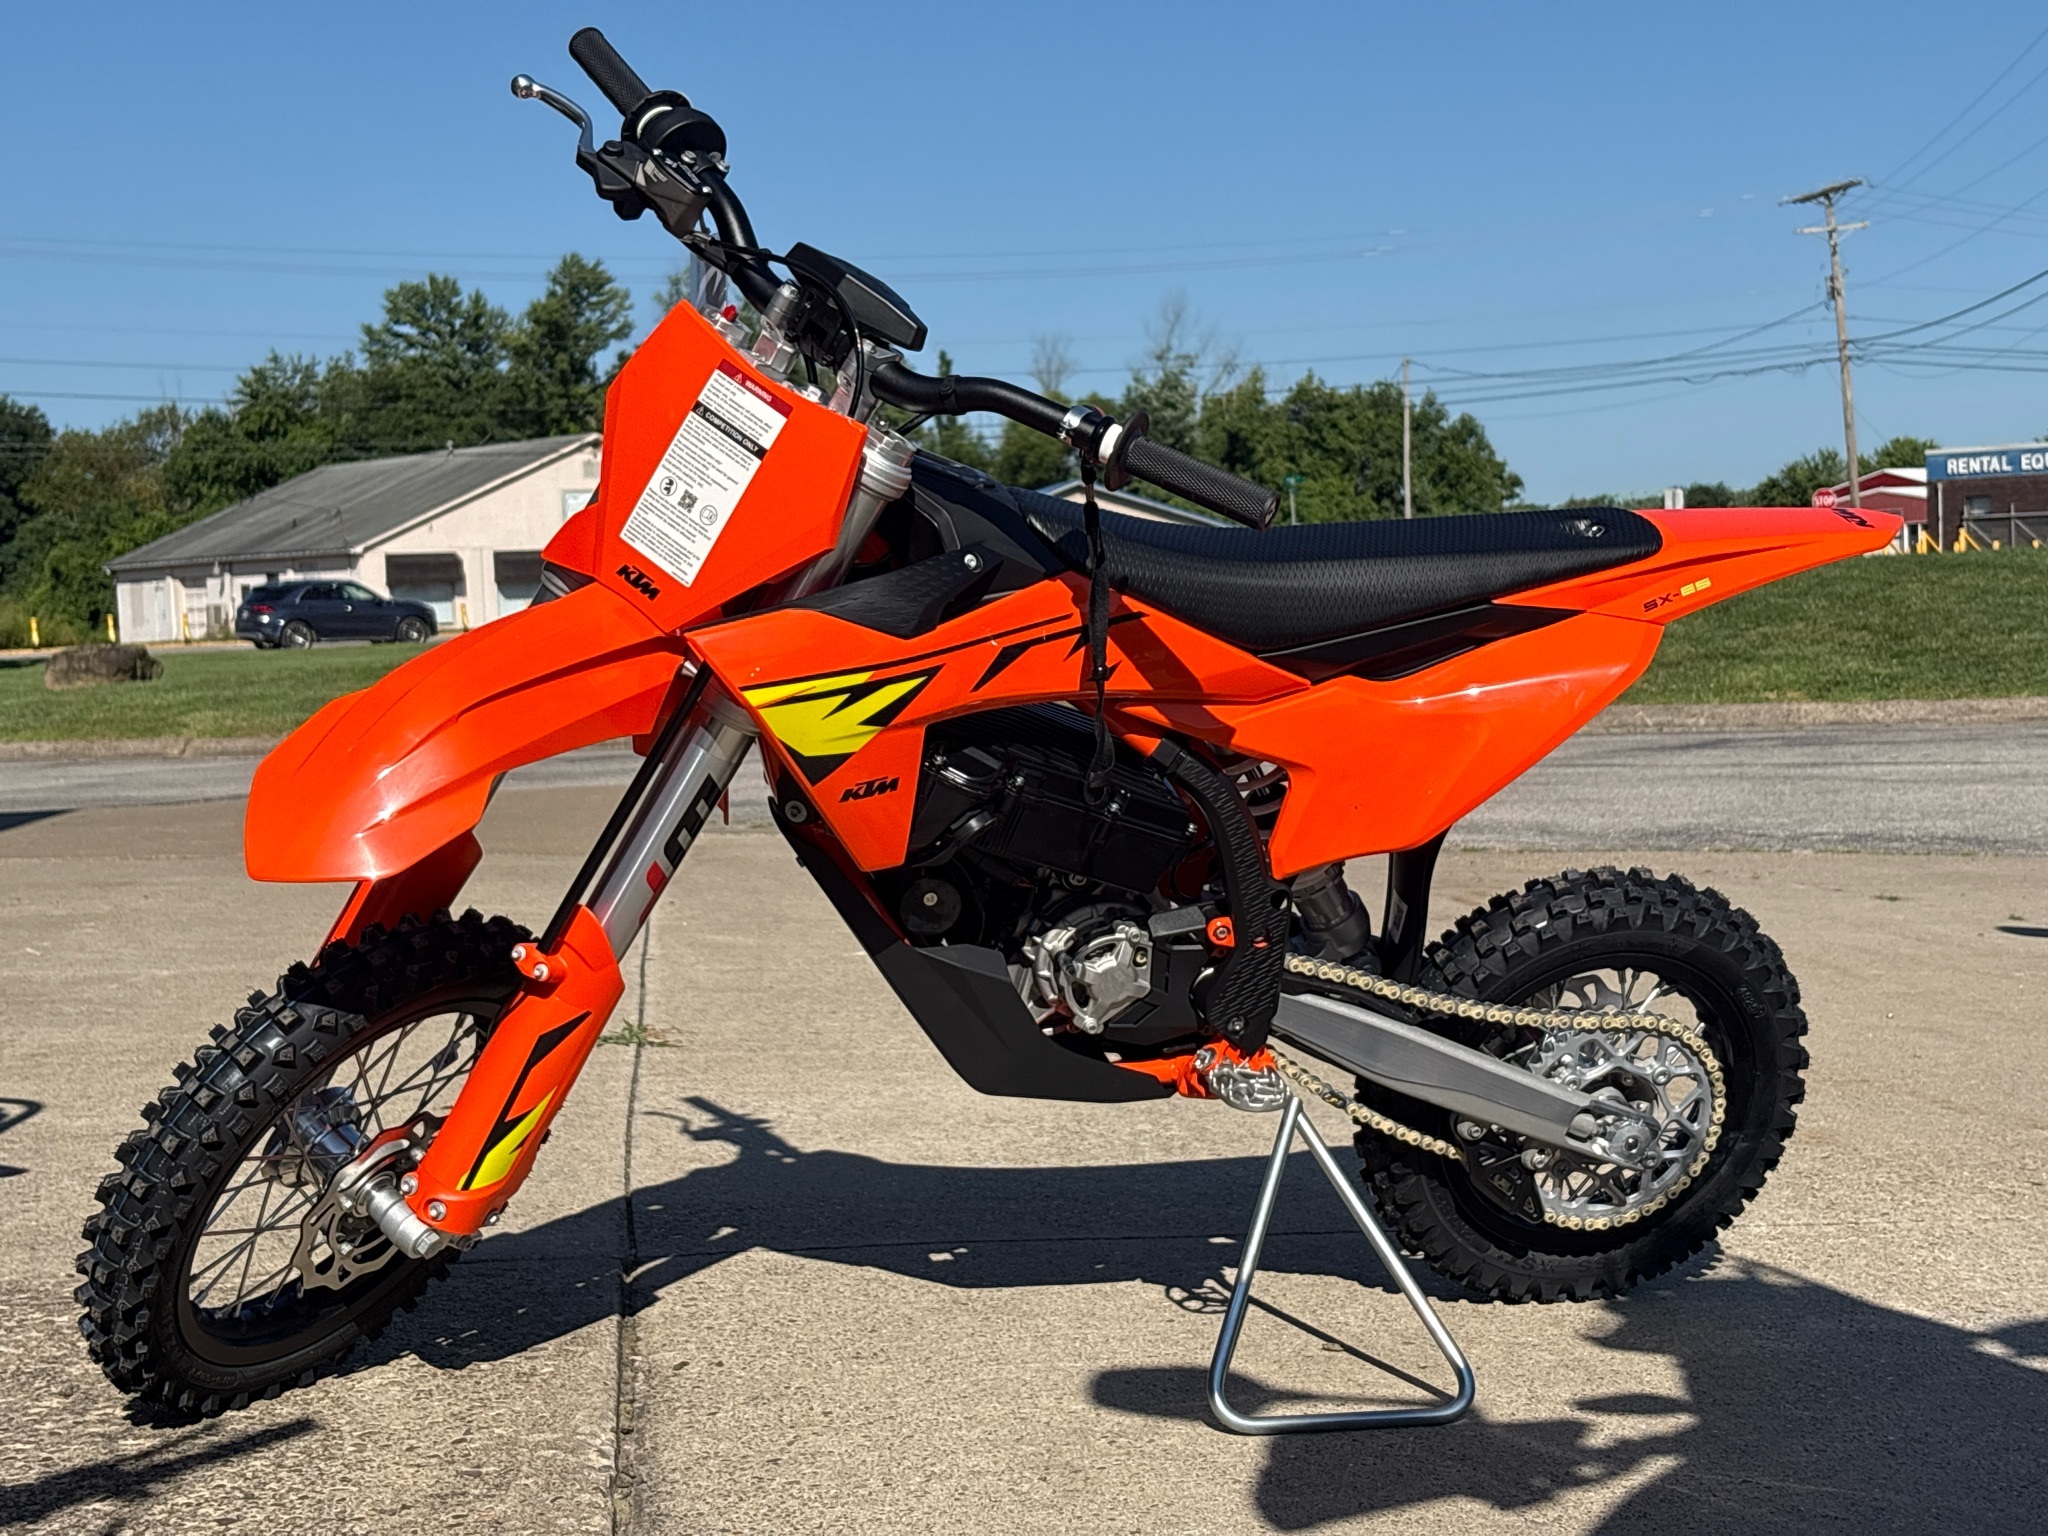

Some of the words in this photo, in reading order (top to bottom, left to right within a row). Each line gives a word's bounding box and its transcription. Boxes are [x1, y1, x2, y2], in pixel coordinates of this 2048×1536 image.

[744, 379, 772, 402] WARNING
[704, 410, 743, 442] COMPETITION
[741, 437, 759, 453] ONLY
[1947, 455, 2013, 475] RENTAL
[1813, 495, 1835, 508] STOP
[615, 564, 661, 601] KTM
[839, 776, 900, 803] KTM
